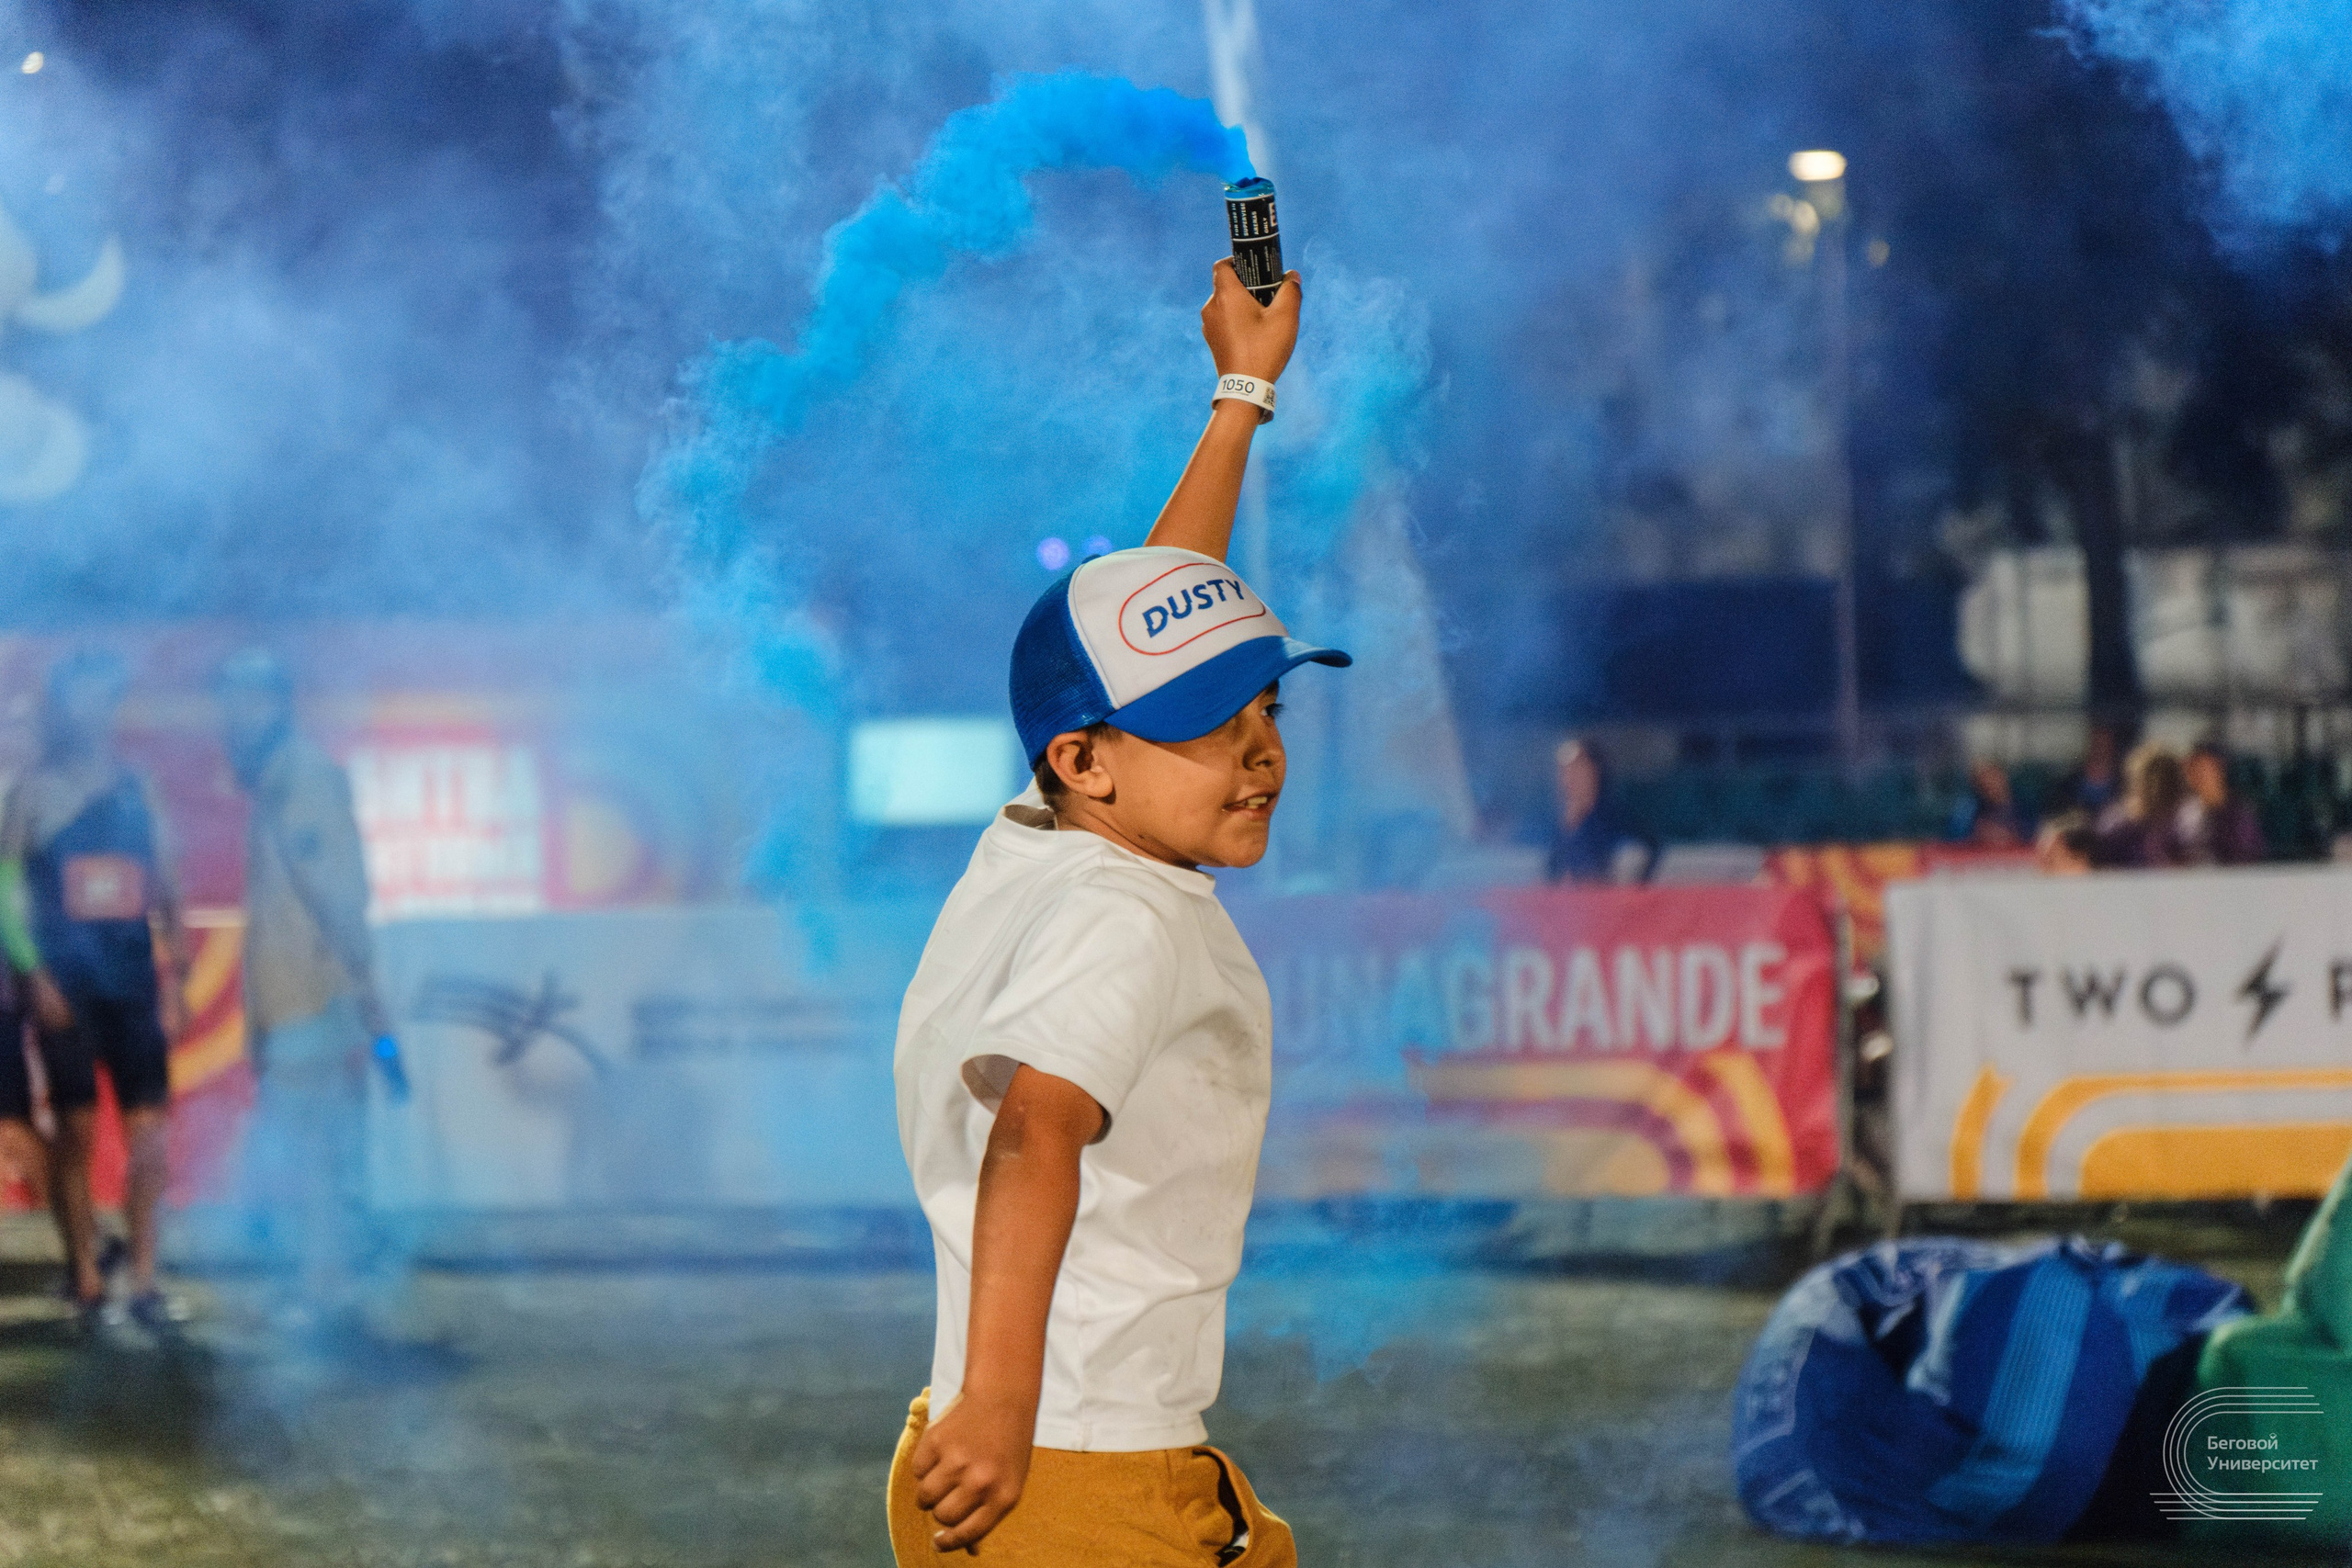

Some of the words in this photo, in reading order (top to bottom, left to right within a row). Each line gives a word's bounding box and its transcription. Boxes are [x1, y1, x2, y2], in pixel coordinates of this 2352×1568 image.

[1222, 378, 1255, 394] 1050
[1142, 579, 1245, 638] DUSTY
[2004, 964, 2198, 1028] TWO
